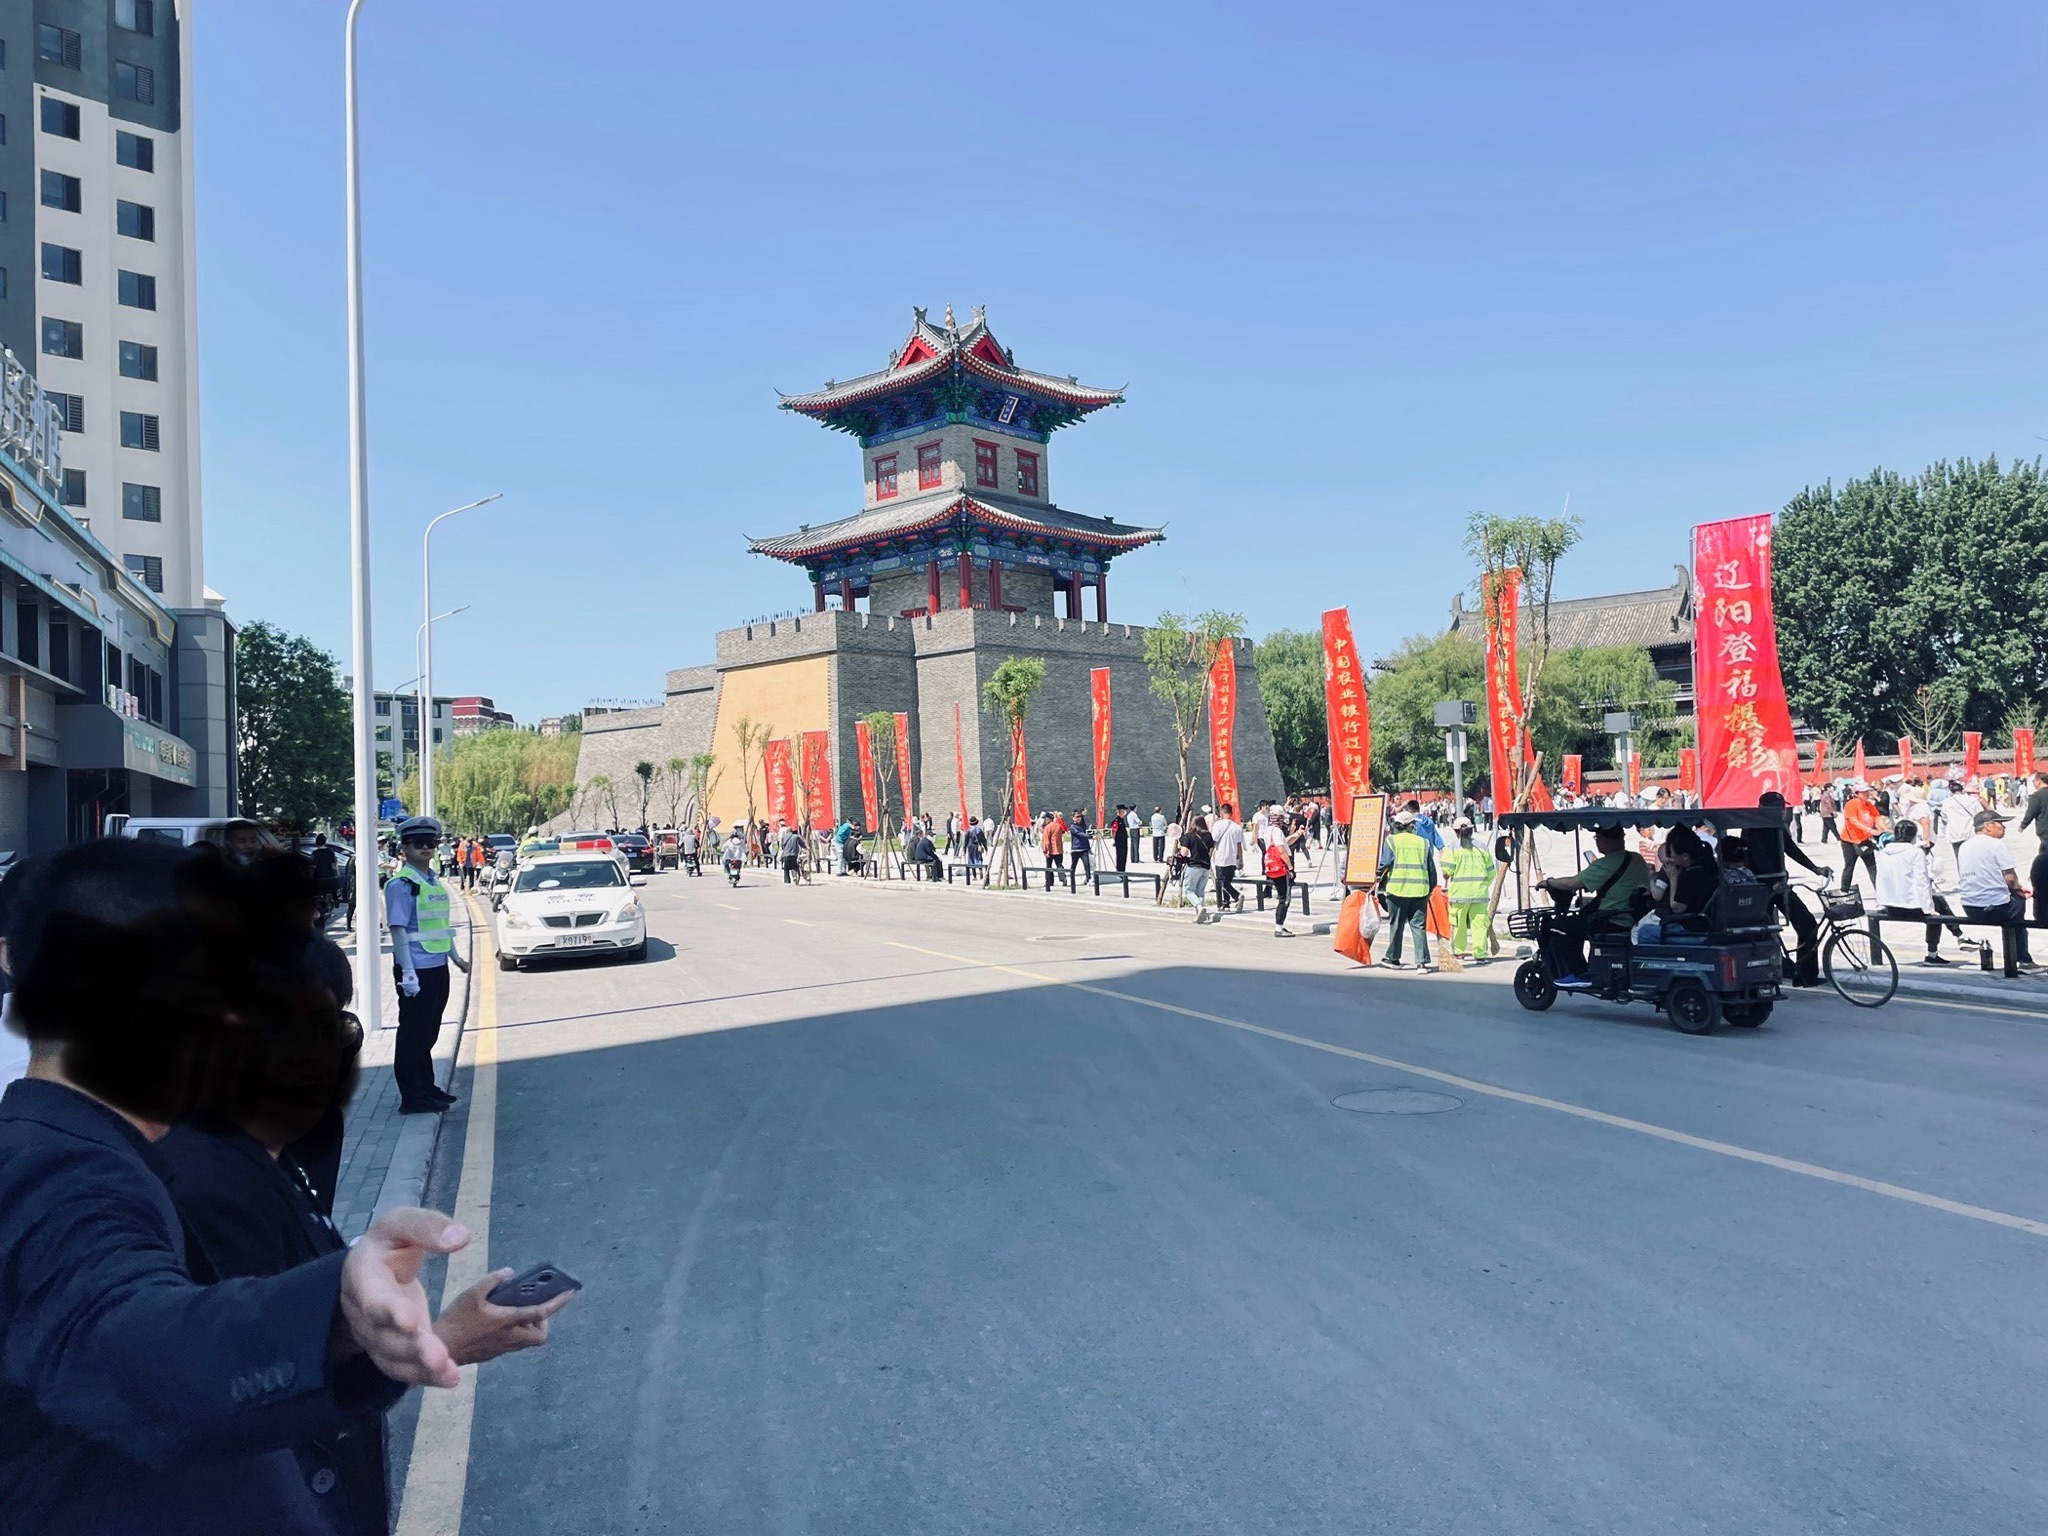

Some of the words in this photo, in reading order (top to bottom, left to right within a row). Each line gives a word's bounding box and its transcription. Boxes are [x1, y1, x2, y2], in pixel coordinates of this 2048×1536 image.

[1713, 559, 1768, 770] 辽阳登福摄影
